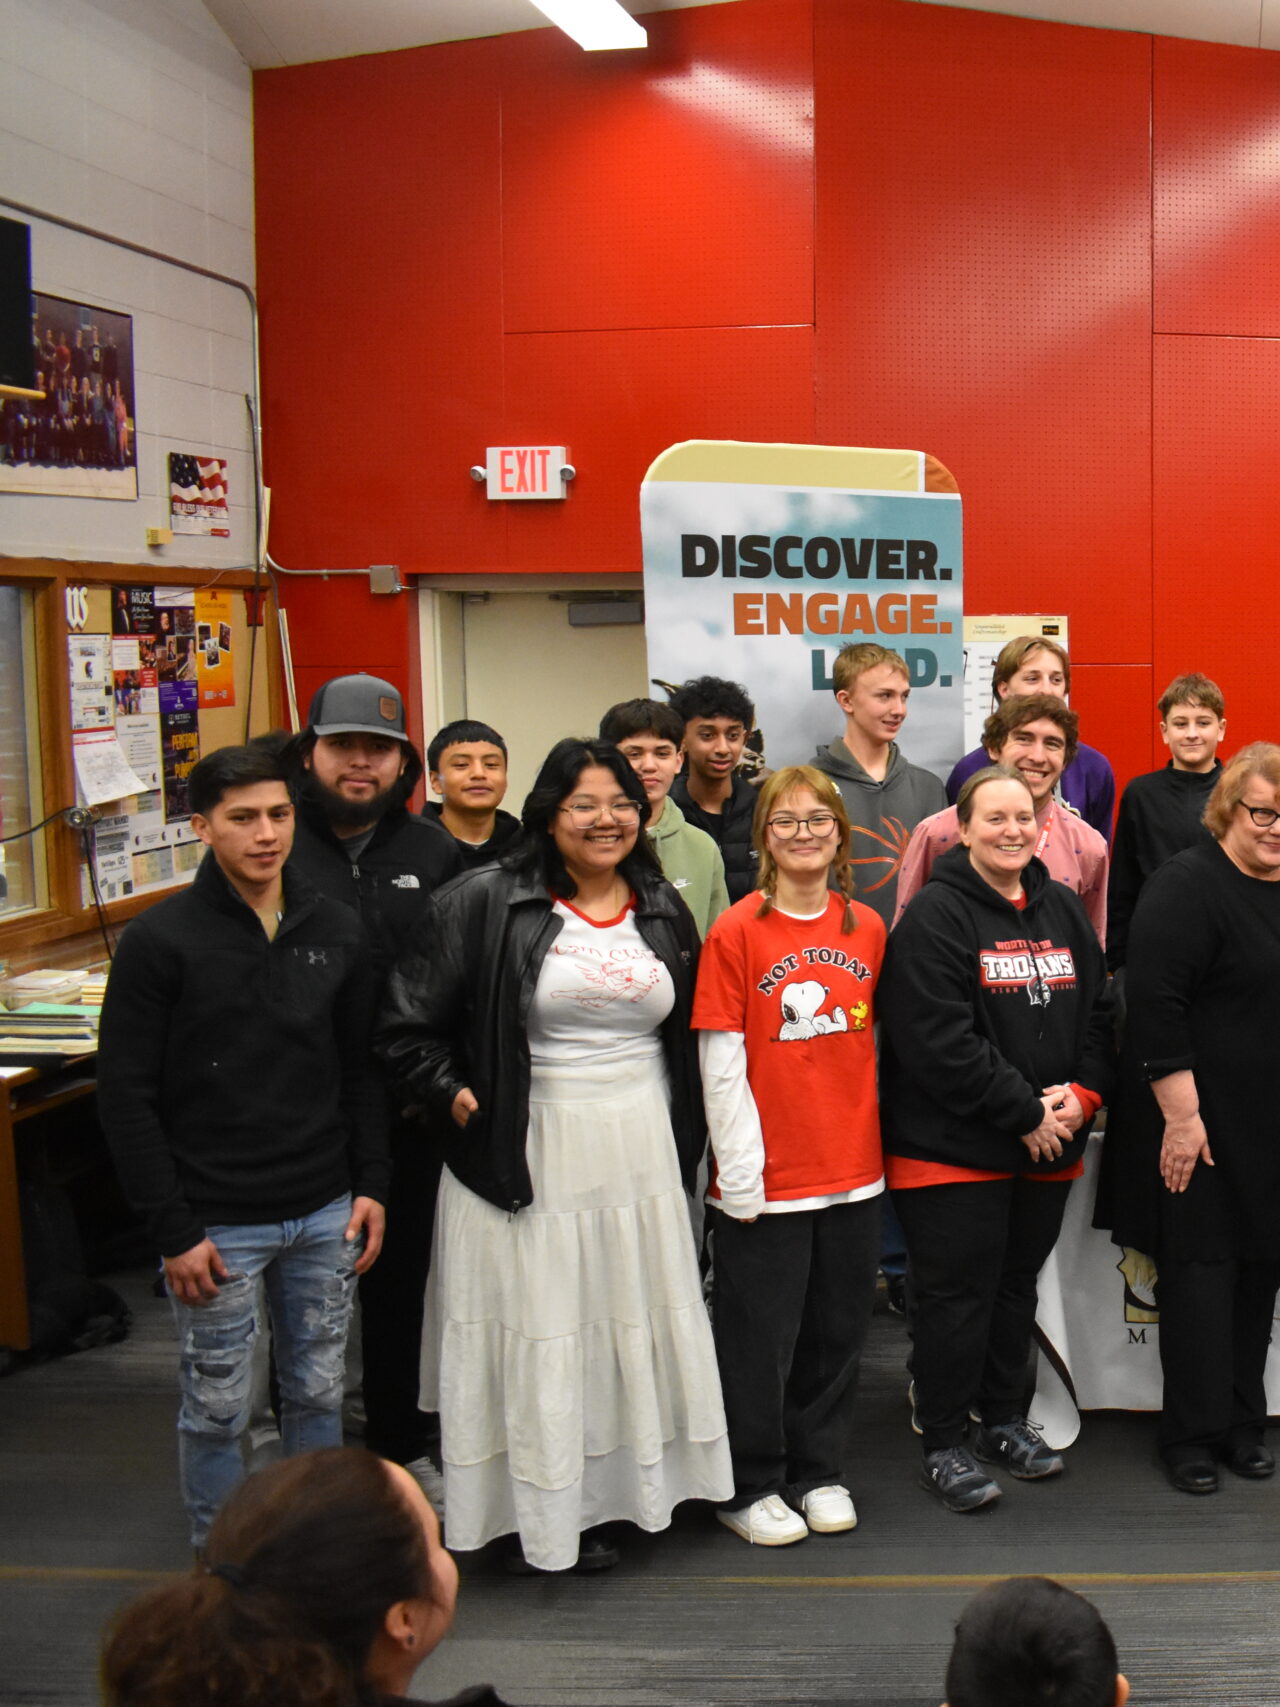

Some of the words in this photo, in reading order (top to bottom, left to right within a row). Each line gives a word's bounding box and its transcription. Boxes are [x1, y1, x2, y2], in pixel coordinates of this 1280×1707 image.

[500, 450, 550, 493] EXIT
[681, 533, 953, 581] DISCOVER.
[131, 591, 153, 604] MUSIC
[733, 592, 953, 636] ENGAGE.
[811, 648, 953, 691] LD.
[758, 954, 799, 996] NOT
[803, 947, 872, 982] TODAY
[982, 953, 1074, 980] TROJANS
